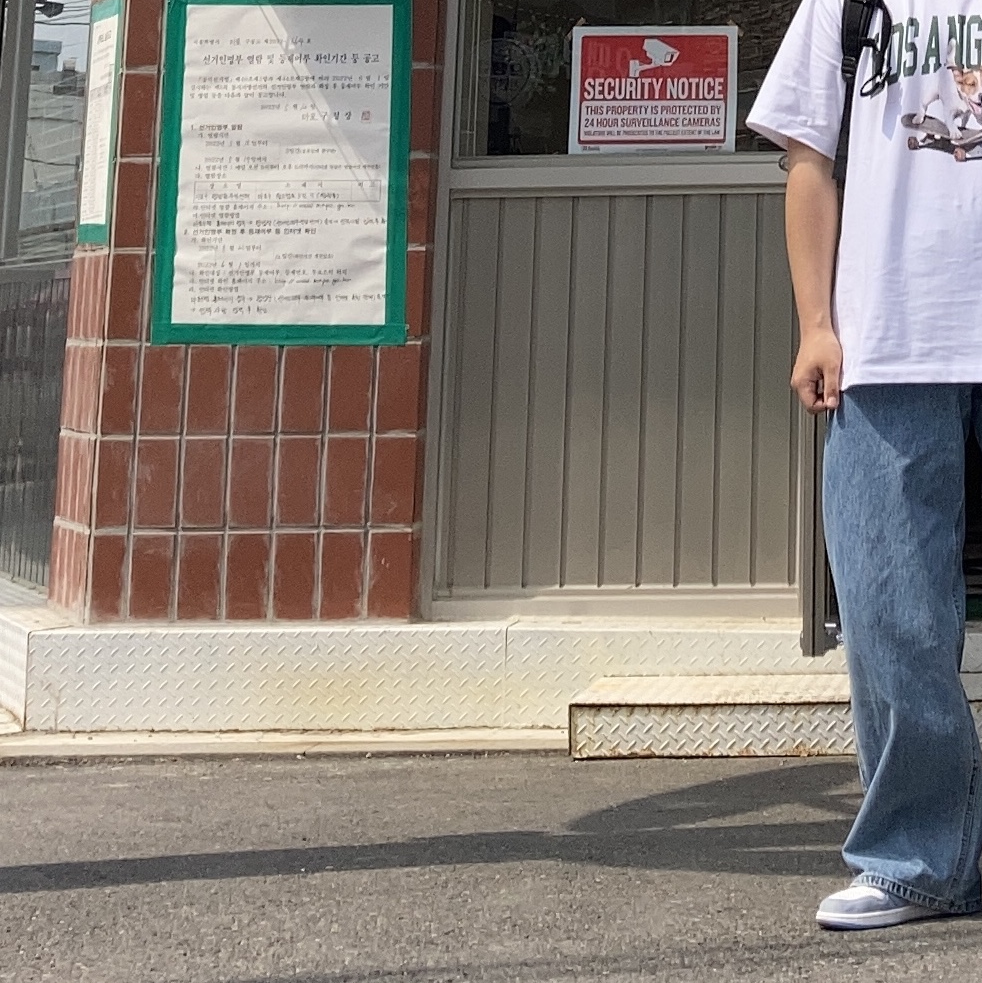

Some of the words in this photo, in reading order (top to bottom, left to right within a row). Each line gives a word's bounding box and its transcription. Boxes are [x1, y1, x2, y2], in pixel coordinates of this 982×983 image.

[583, 77, 663, 100] SECURITY
[666, 77, 724, 100] NOTICE
[585, 105, 603, 115] THIS
[605, 105, 649, 116] PROPERTY
[651, 105, 659, 115] IS
[660, 105, 708, 115] PROTECTED
[710, 105, 721, 115] BY
[584, 118, 595, 128] 24
[596, 118, 618, 128] HOUR
[620, 118, 679, 128] SURVEILLANCE
[681, 117, 720, 128] CAMERAS
